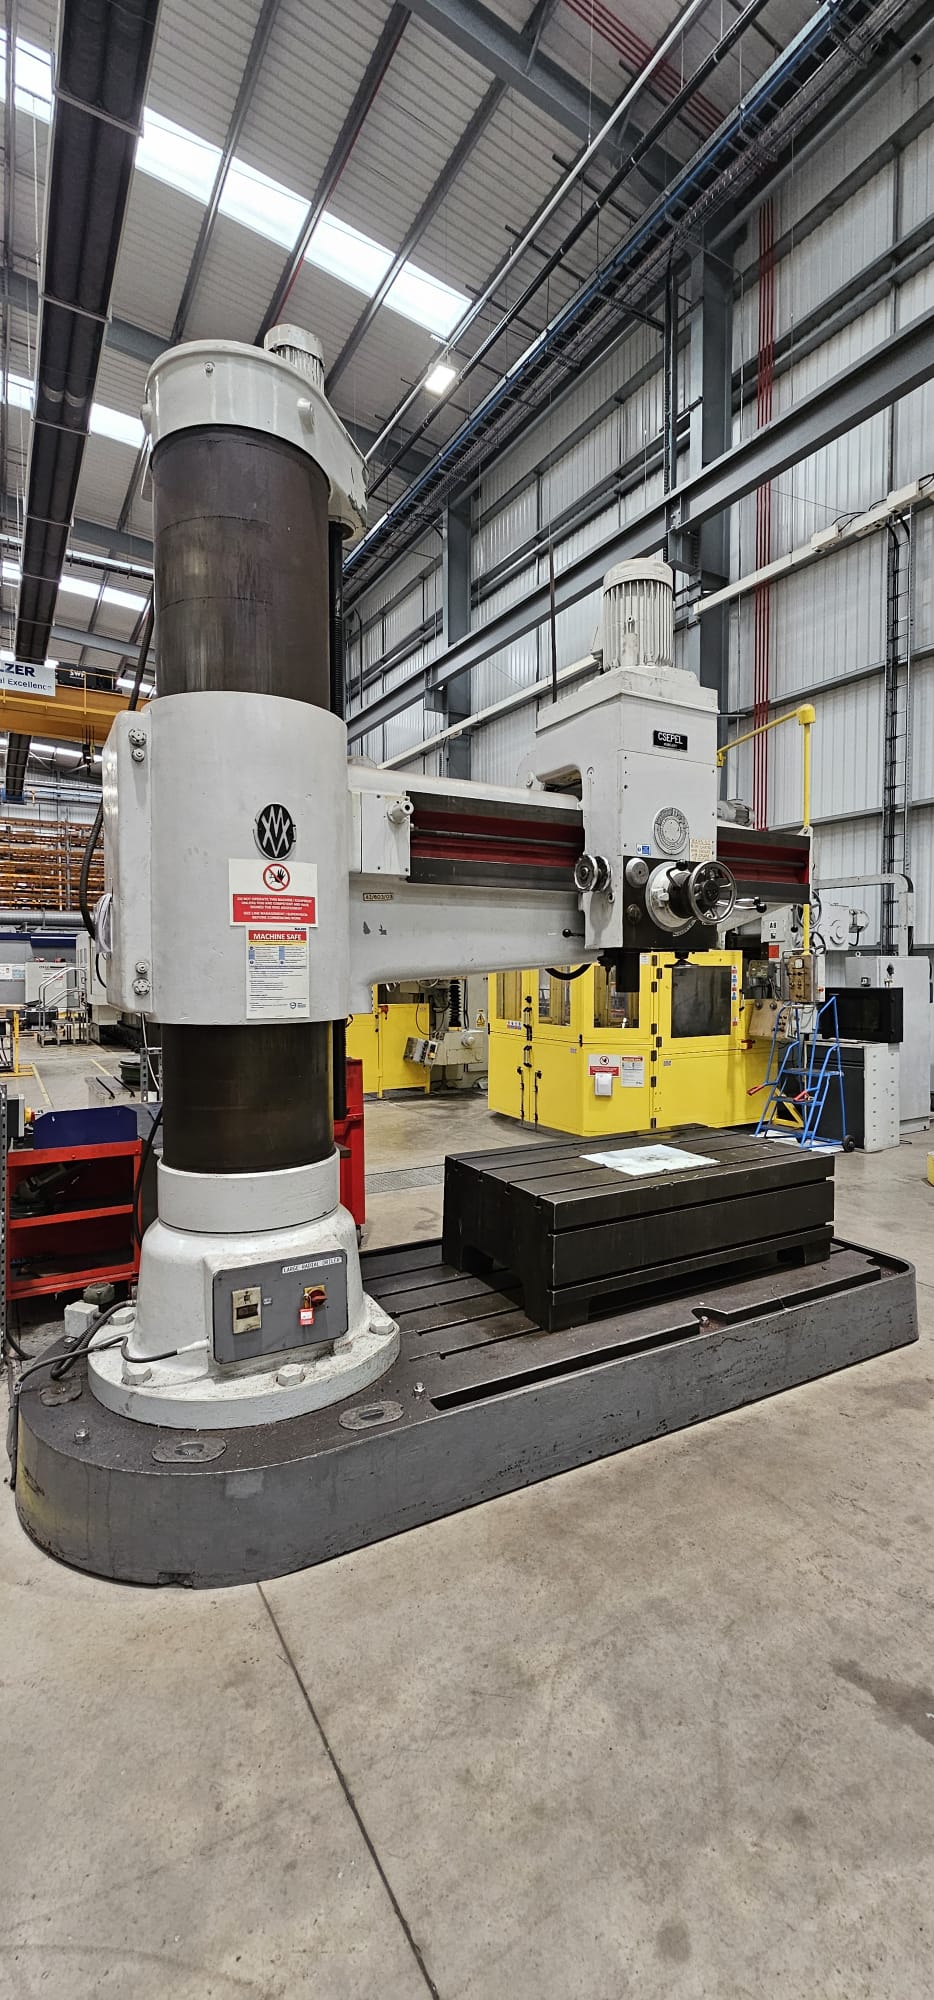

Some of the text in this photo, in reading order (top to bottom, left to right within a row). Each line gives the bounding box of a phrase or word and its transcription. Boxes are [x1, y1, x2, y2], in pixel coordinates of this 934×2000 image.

[657, 732, 684, 745] CSEPEL
[253, 932, 302, 941] MACHINE SAFE
